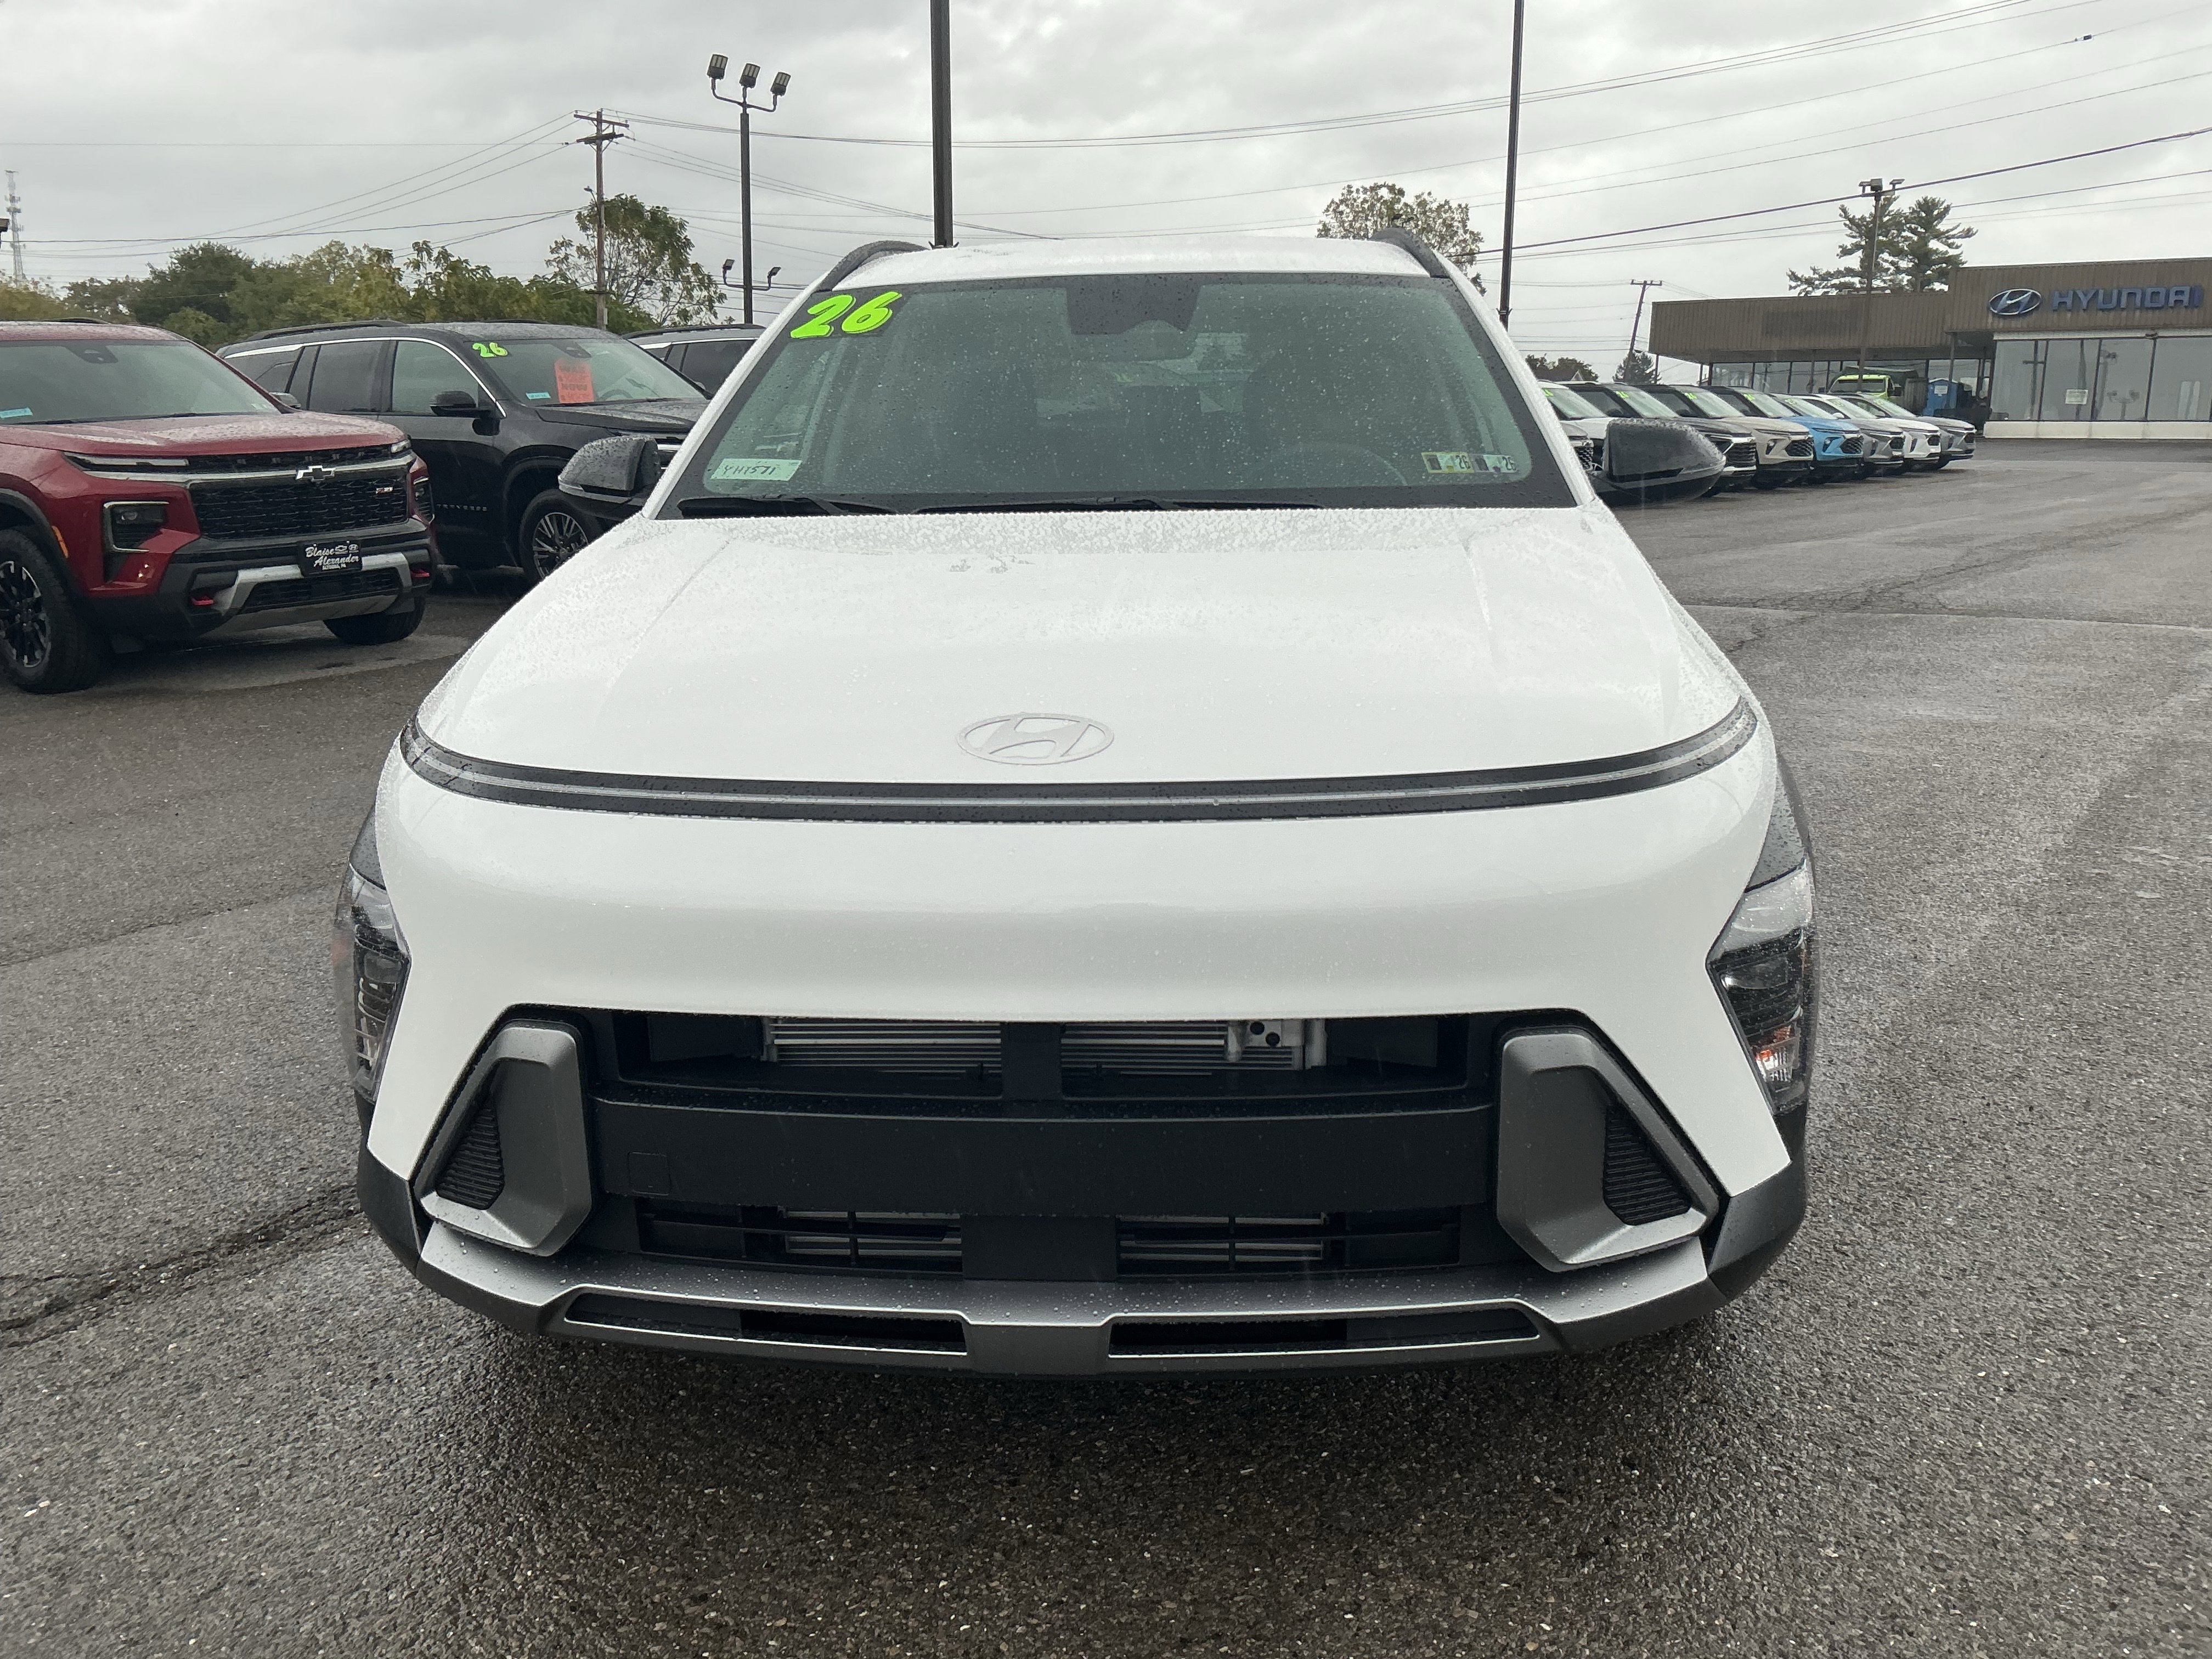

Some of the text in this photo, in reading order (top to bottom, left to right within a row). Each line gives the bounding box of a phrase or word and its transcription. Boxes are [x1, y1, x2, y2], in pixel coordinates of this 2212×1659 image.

[2052, 285, 2203, 311] HYUNDAI
[789, 290, 902, 339] 26
[472, 341, 509, 358] 26
[305, 546, 335, 557] Blaise
[313, 554, 359, 567] Alexander
